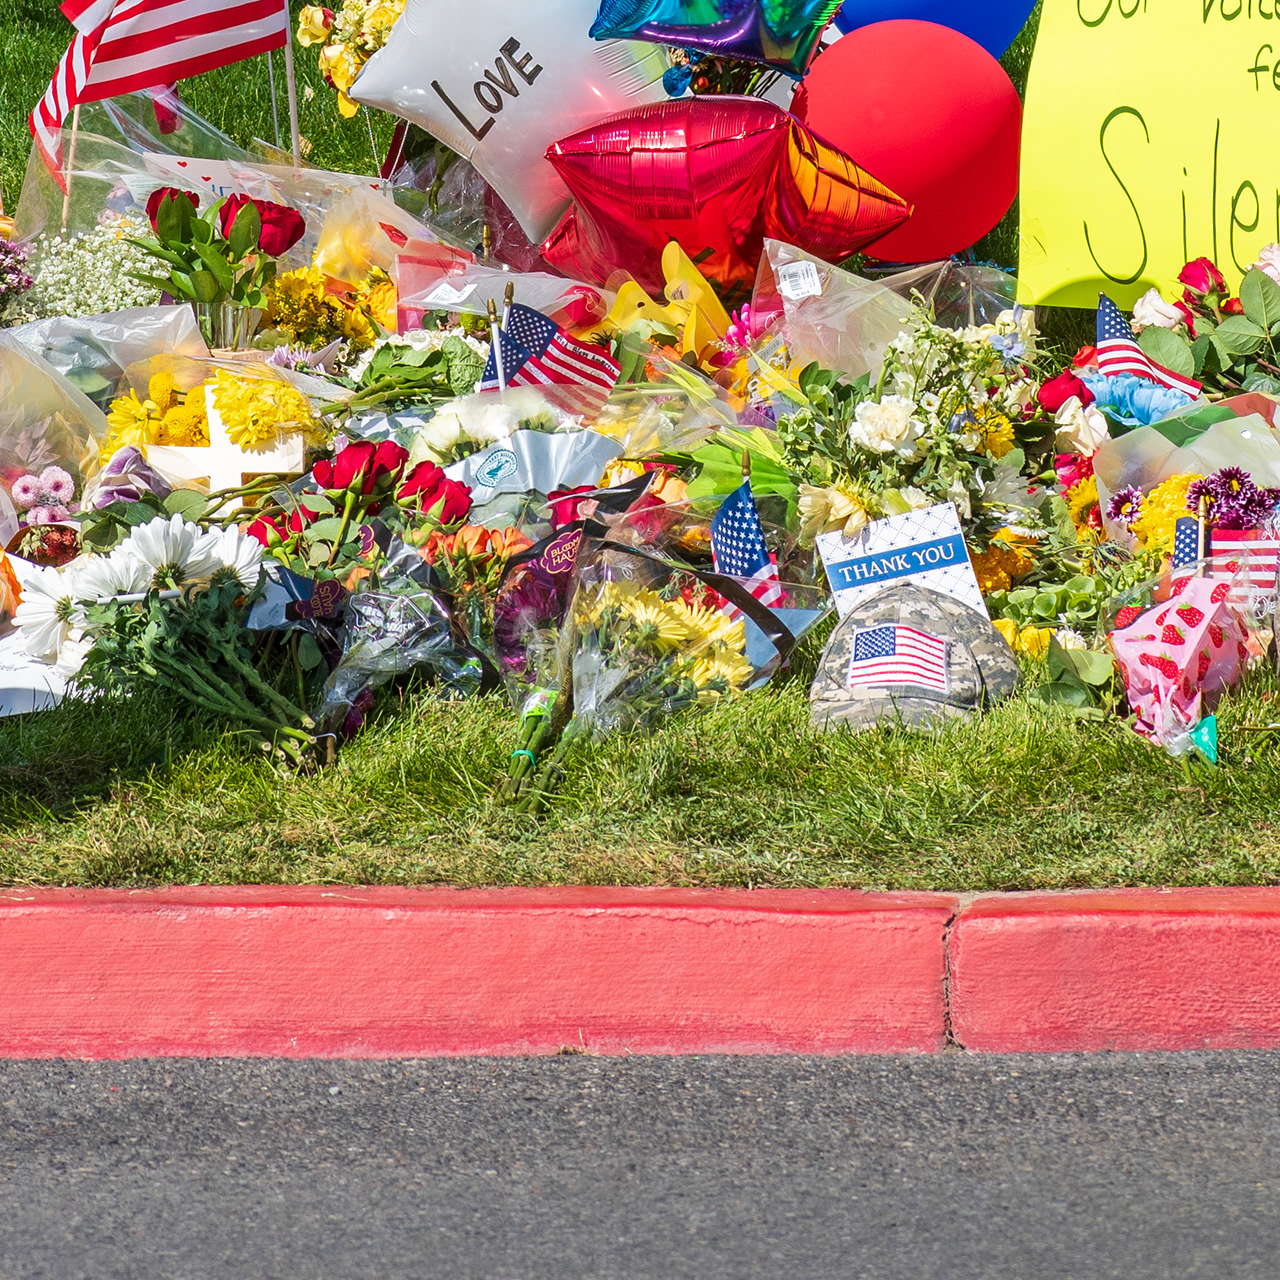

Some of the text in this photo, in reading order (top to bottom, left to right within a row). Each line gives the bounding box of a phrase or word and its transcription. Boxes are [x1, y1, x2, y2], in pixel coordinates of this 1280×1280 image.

[430, 36, 544, 142] LOVE
[839, 542, 955, 583] THANK YOU
